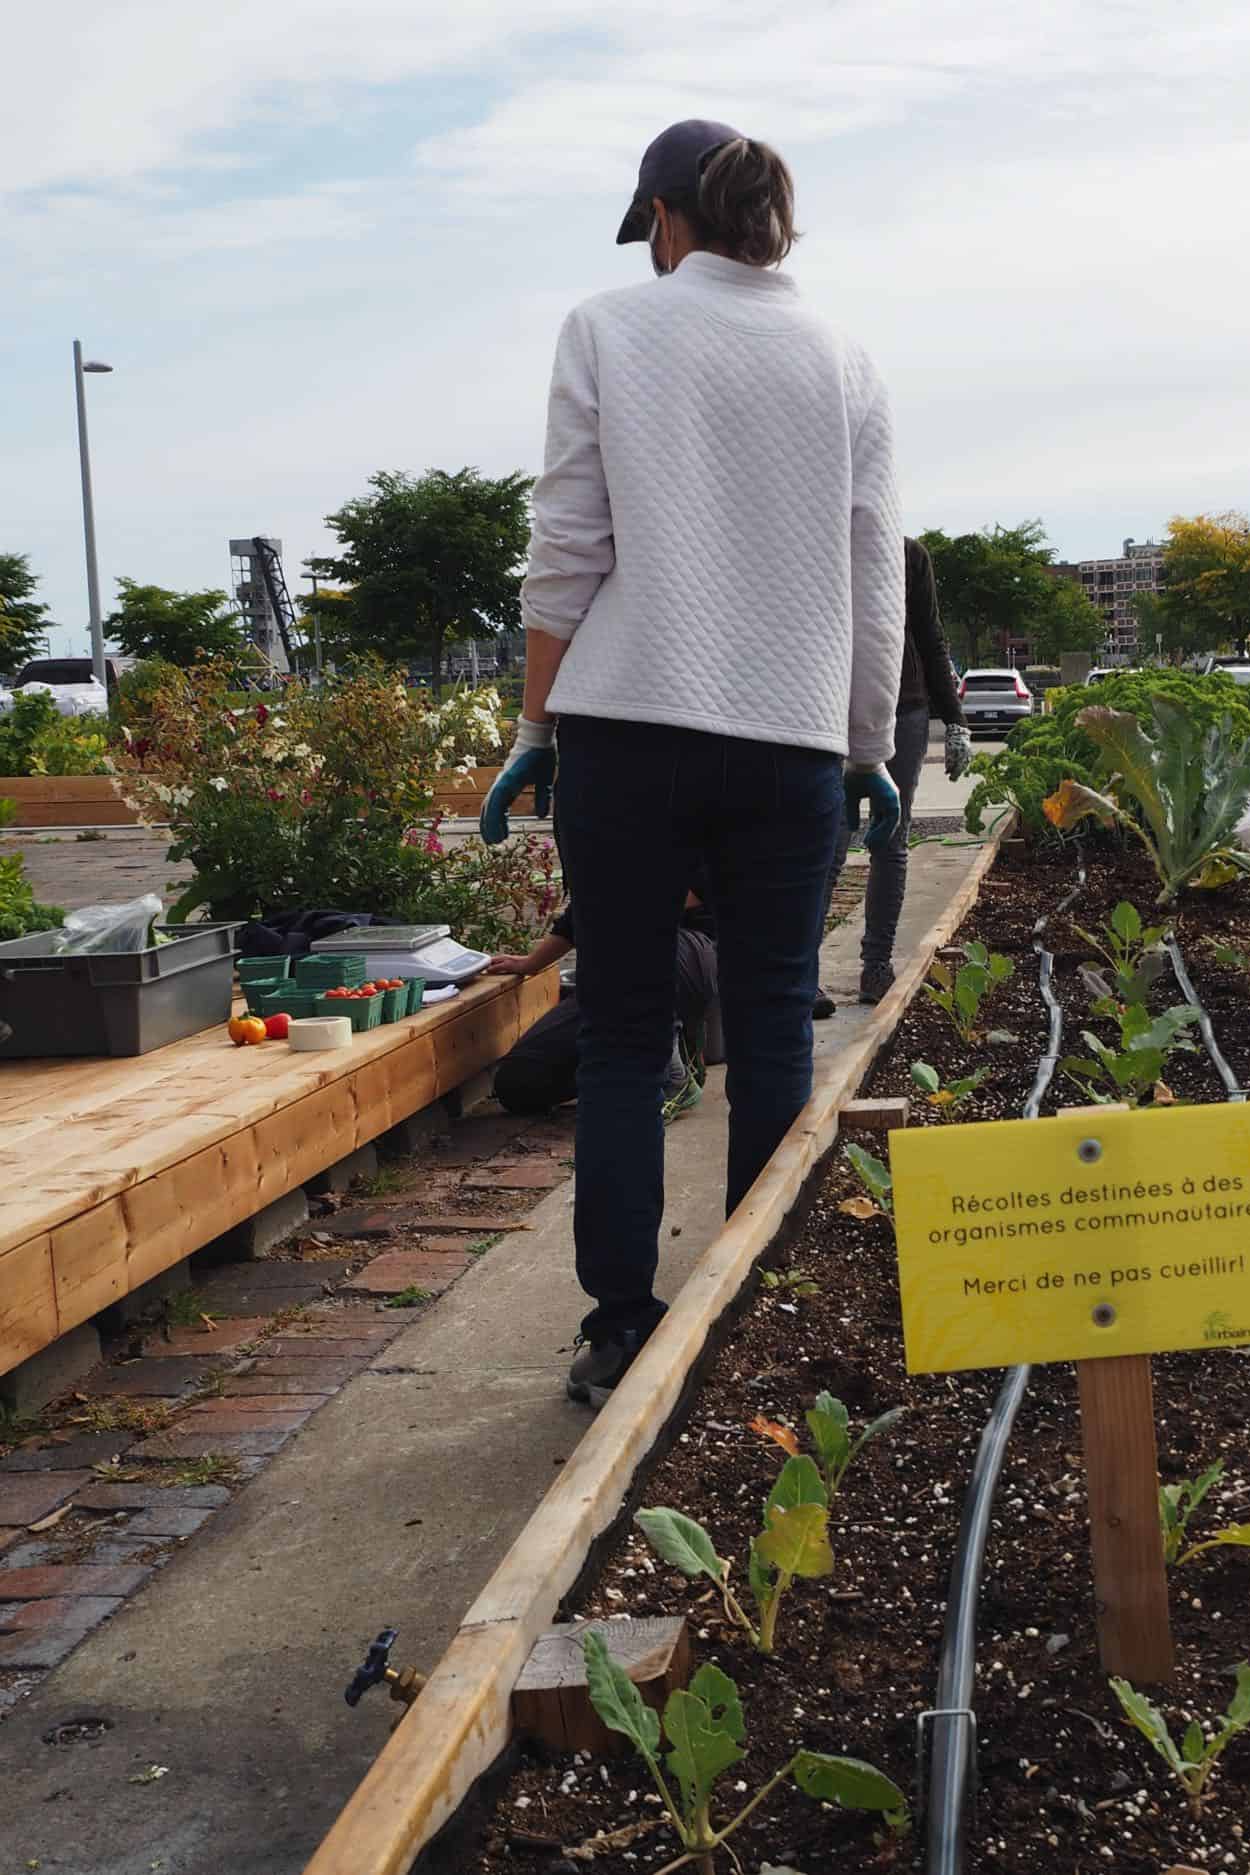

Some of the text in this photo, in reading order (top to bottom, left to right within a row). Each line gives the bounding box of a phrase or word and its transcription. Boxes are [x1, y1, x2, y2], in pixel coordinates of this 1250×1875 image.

[951, 1175, 1244, 1215] Récoltes destinées à des
[928, 1219, 1066, 1247] organismes
[963, 1255, 1245, 1297] Merci de ne pas cueillir!
